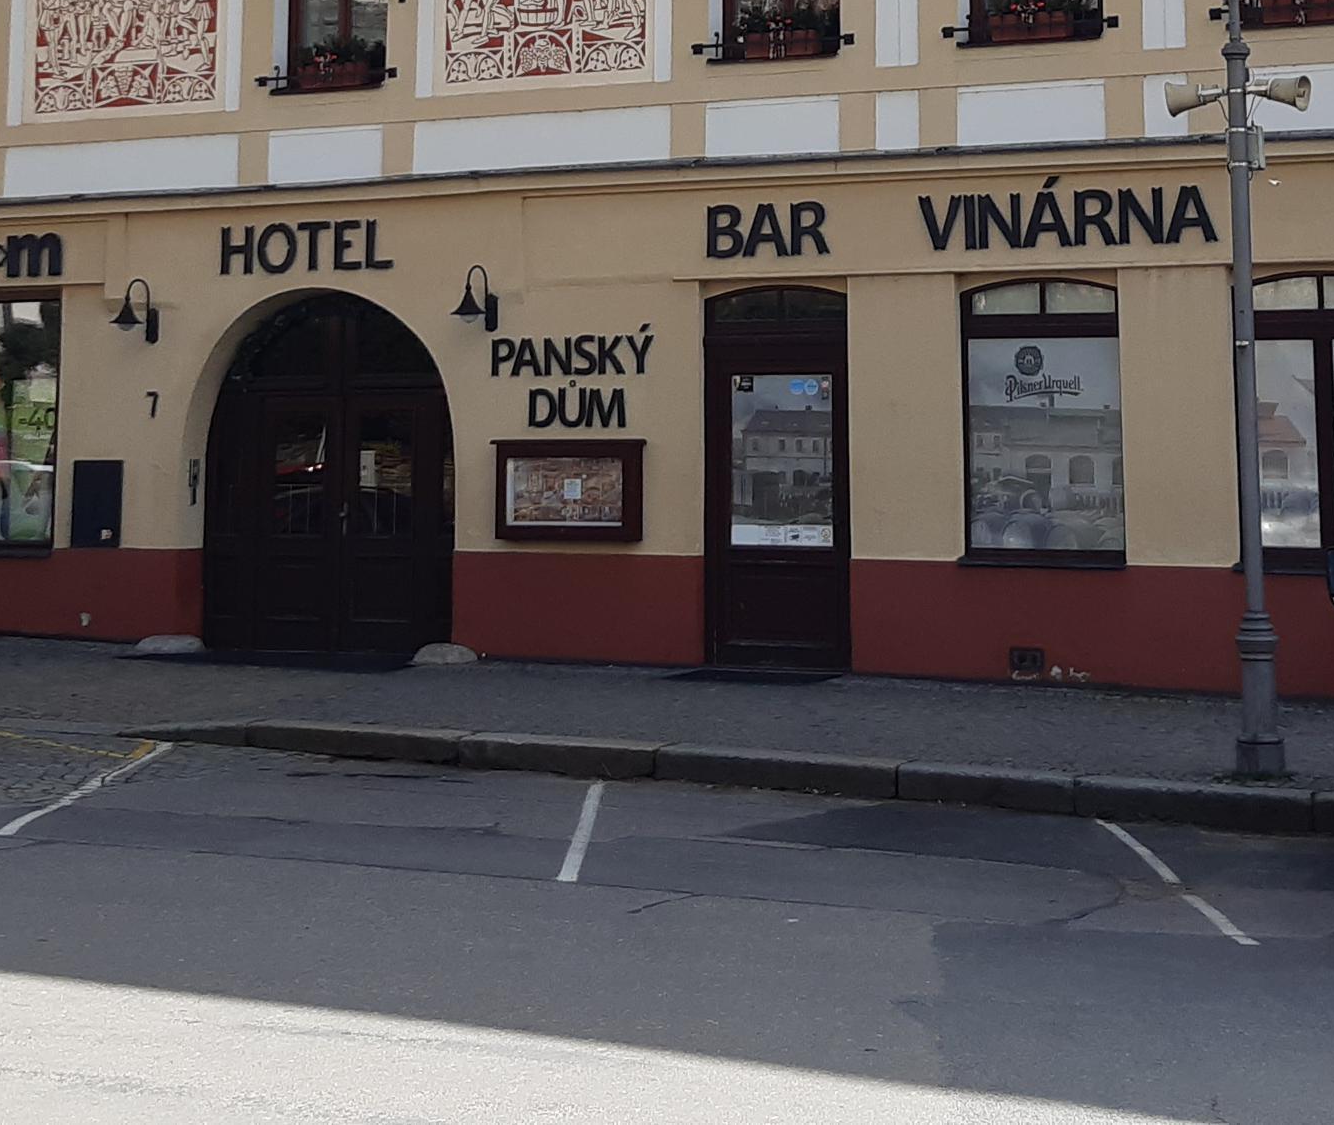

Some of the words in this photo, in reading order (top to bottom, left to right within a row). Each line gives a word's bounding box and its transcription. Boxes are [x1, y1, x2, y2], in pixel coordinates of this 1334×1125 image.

[705, 201, 831, 259] BAR
[917, 176, 1219, 251] VINÁRNA
[219, 218, 394, 276] HOTEL
[490, 322, 655, 377] PANSKÝ
[145, 391, 159, 419] 7
[527, 379, 627, 429] DŮM
[1004, 374, 1043, 403] Pilsner
[1042, 372, 1082, 396] Urquell
